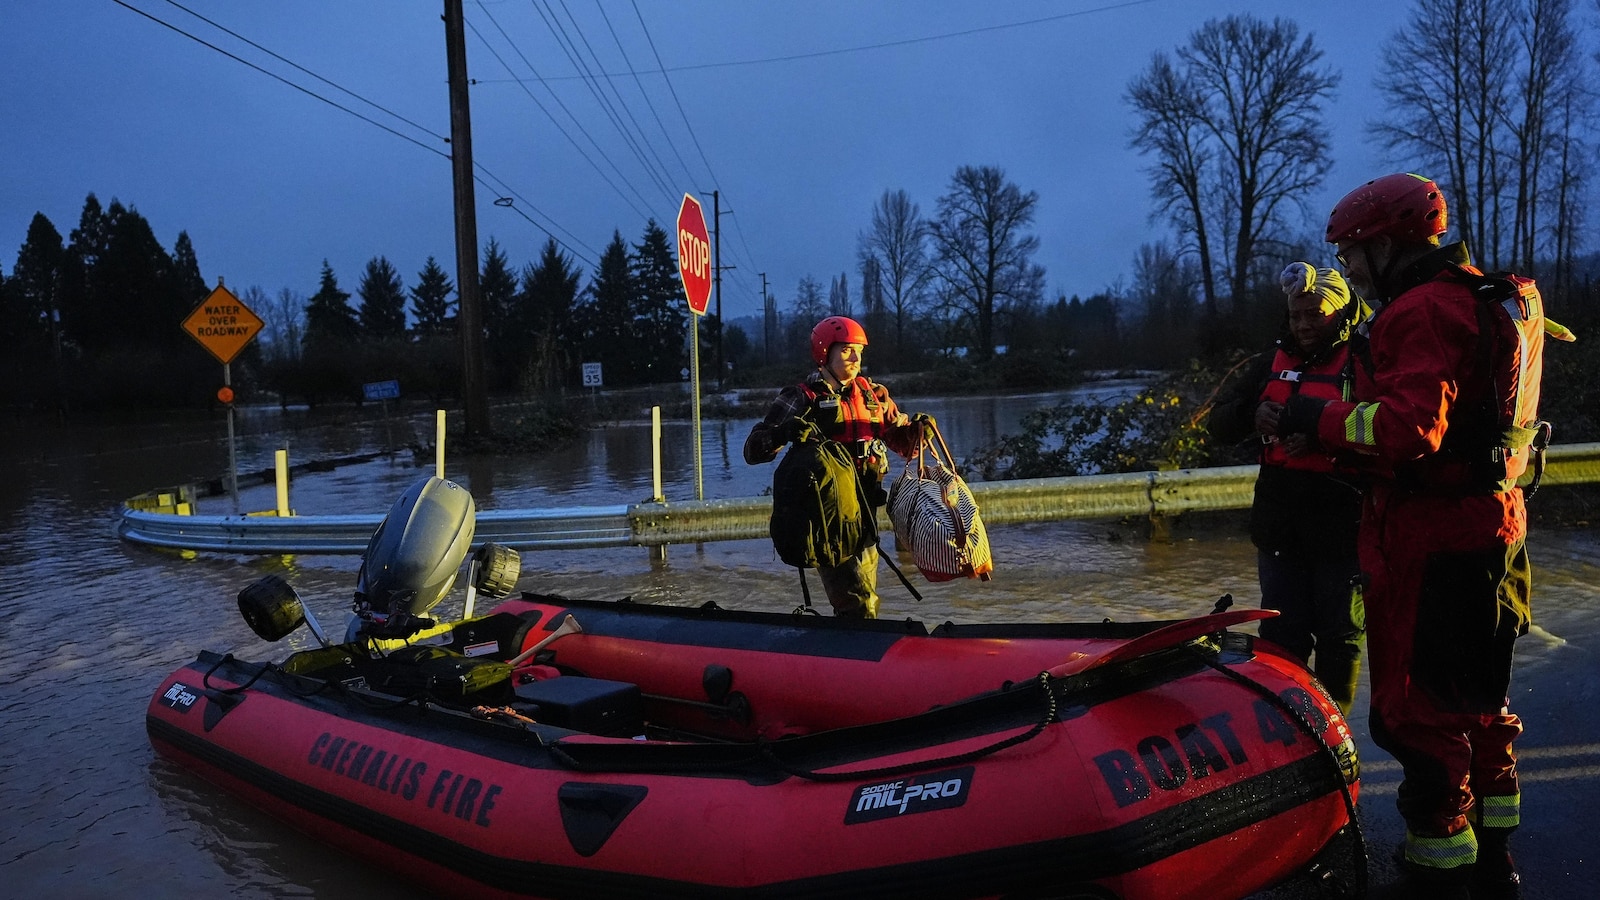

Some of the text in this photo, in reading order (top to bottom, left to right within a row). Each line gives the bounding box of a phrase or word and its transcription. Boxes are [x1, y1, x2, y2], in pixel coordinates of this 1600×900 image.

[681, 228, 709, 280] STOP
[204, 305, 240, 315] WATER
[208, 316, 237, 326] OVER
[197, 326, 249, 337] ROADWAY
[585, 375, 599, 384] 35
[1093, 686, 1330, 808] BOAT 48
[307, 731, 504, 828] CHEHALIS FIRE
[861, 780, 904, 796] ZODIAC
[855, 778, 962, 815] MILPRO
